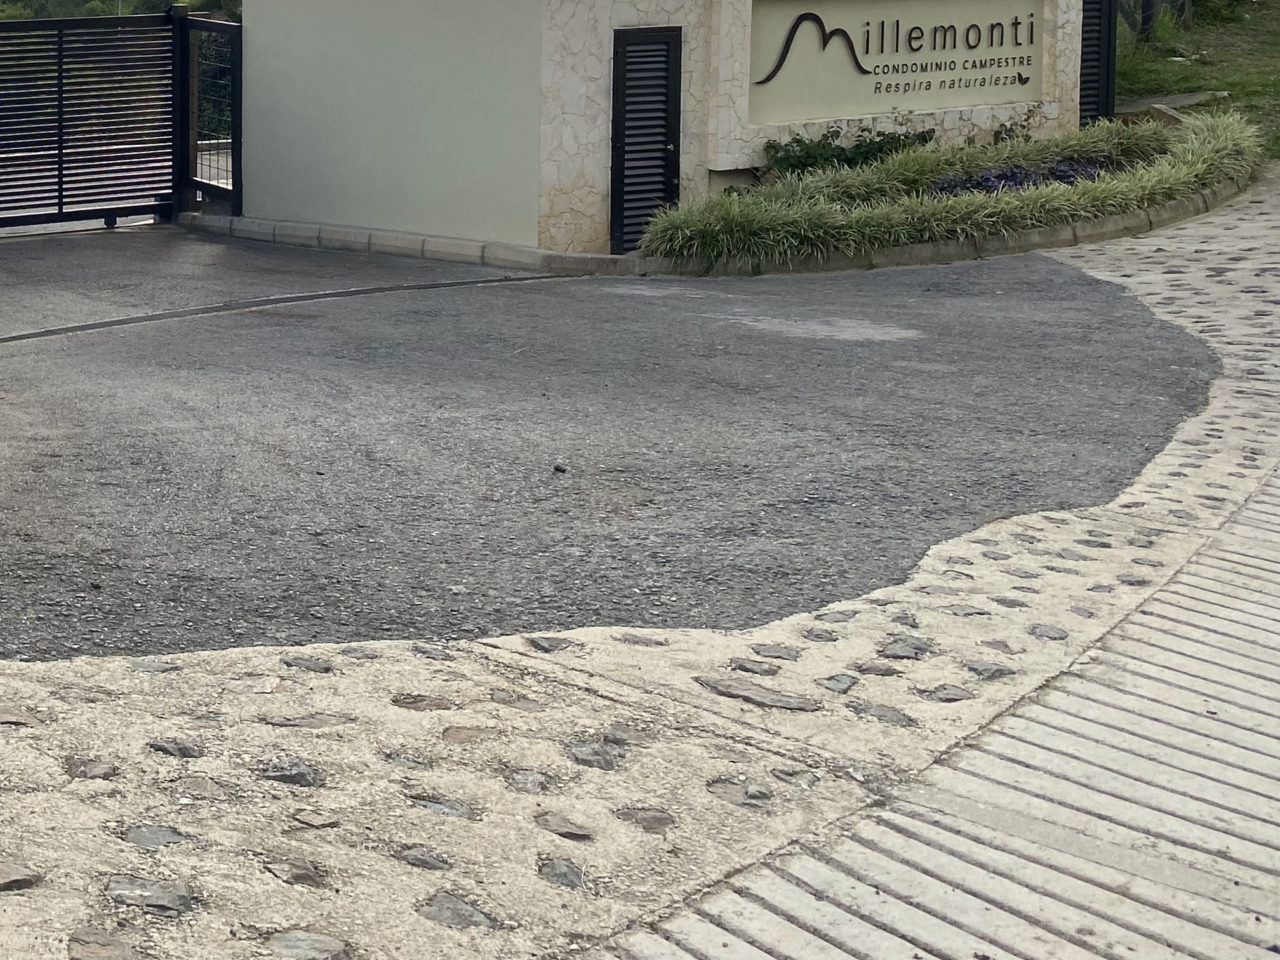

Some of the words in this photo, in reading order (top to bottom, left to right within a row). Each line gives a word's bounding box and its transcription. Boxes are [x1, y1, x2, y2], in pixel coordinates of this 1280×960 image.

[873, 60, 957, 76] CONDOMINIO
[962, 55, 1033, 70] CAMPESTRE
[873, 79, 932, 95] Respira
[939, 74, 1017, 90] naturaleza
